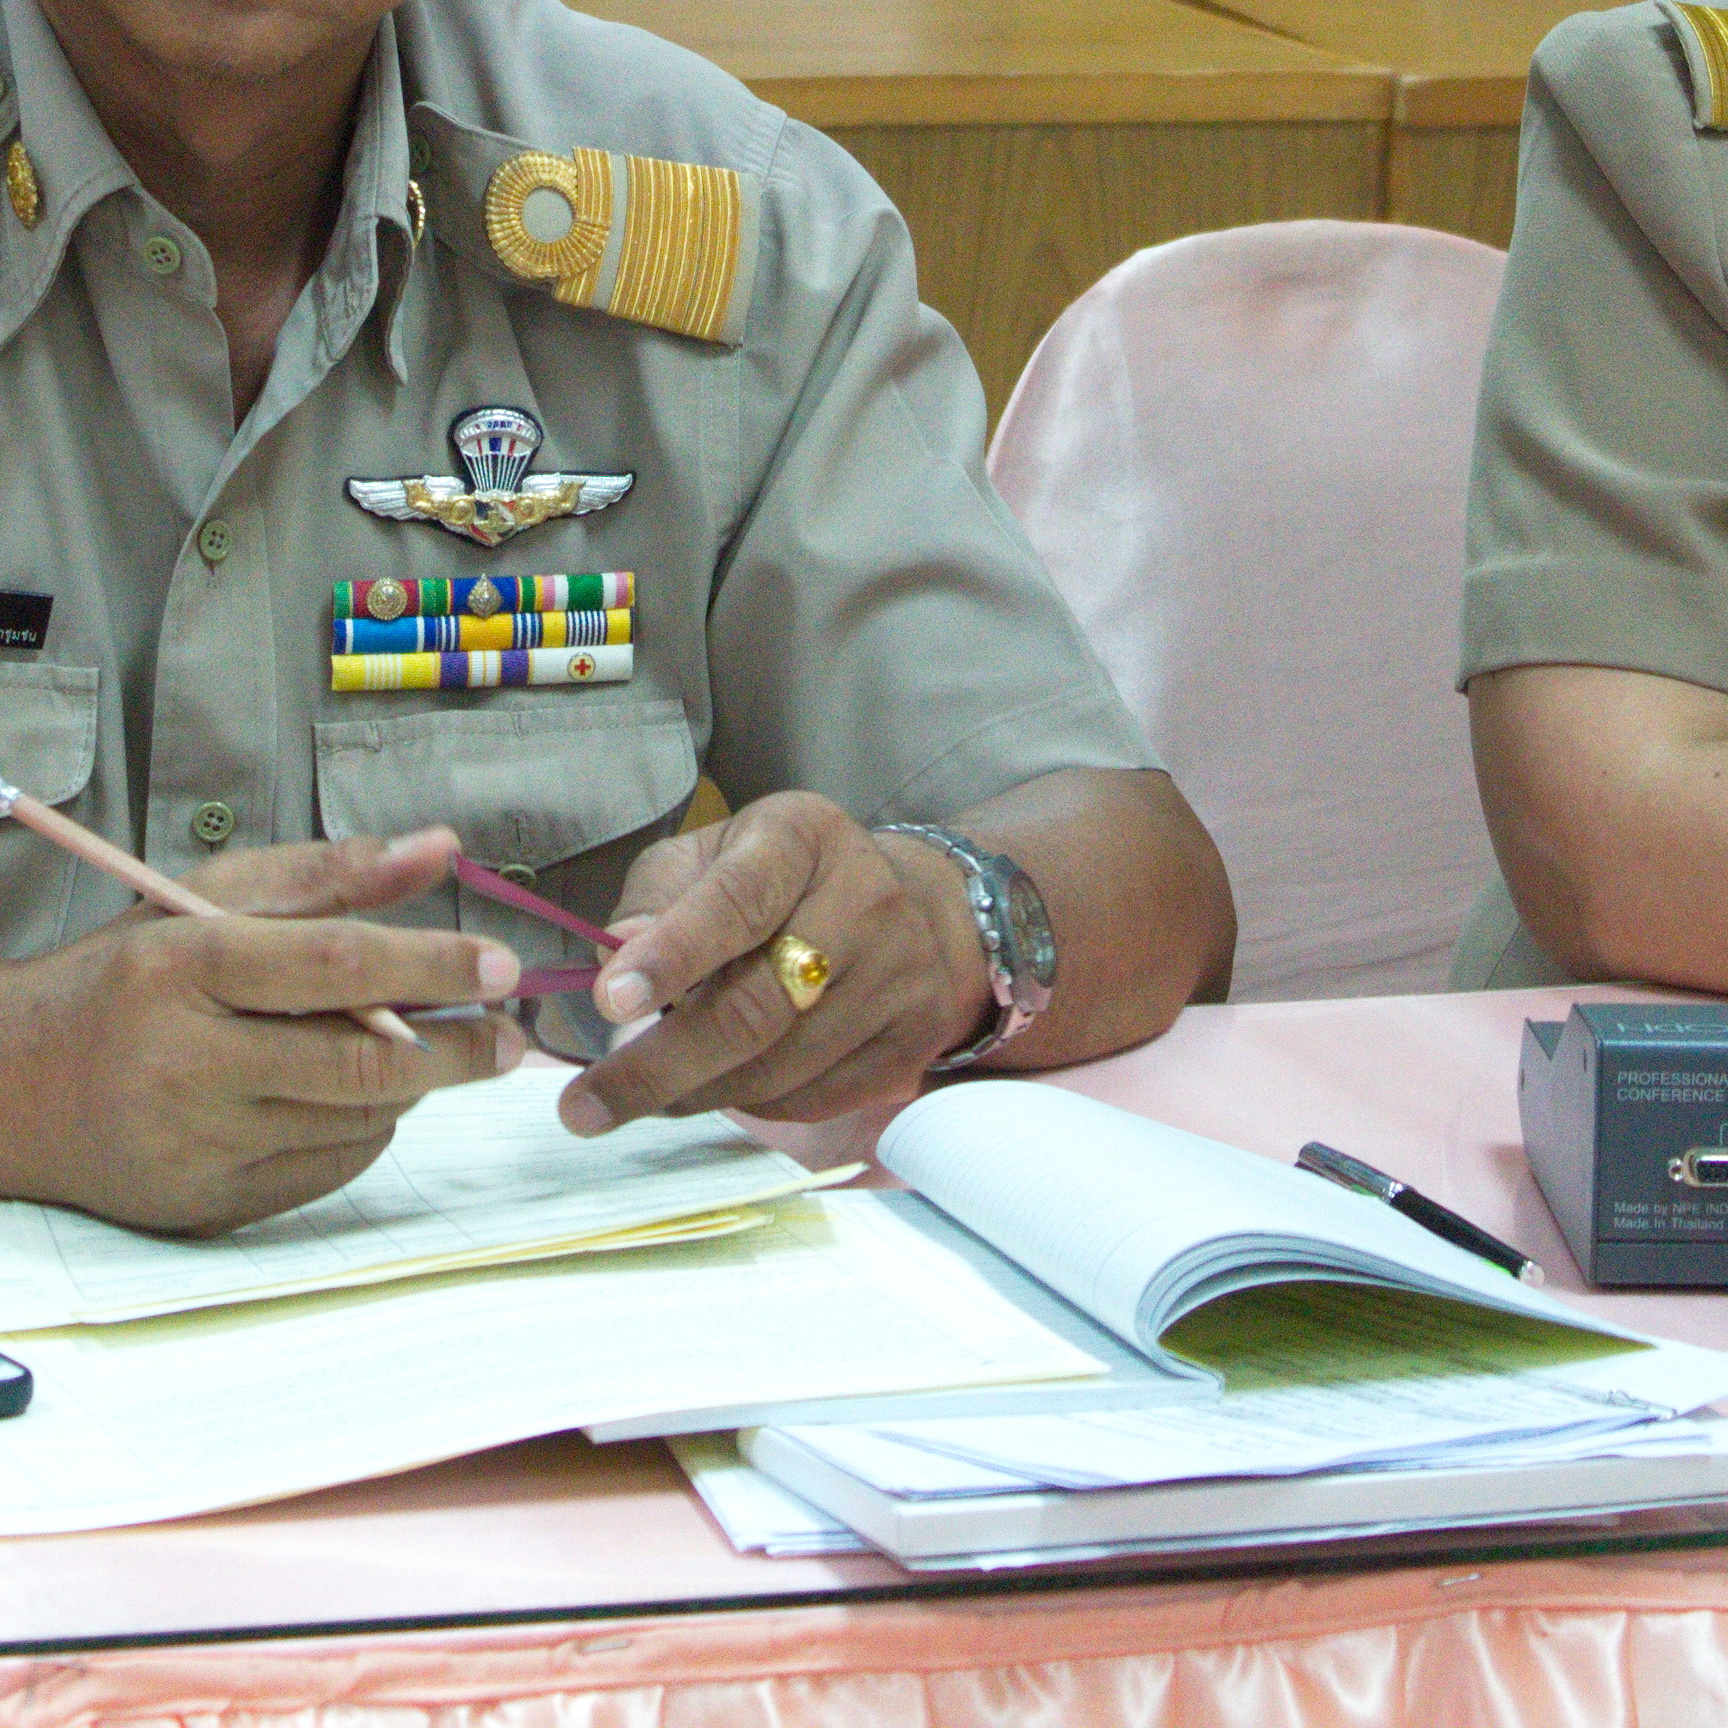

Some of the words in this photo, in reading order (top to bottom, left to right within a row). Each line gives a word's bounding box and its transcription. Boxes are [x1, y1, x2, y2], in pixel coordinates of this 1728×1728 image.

[1616, 1088, 1724, 1103] CONFERENCE
[1614, 1202, 1649, 1215] Made
[1653, 1202, 1668, 1218] by
[1672, 1202, 1700, 1215] NPE
[1614, 1217, 1649, 1230] Made
[1671, 1218, 1725, 1231] Thailand
